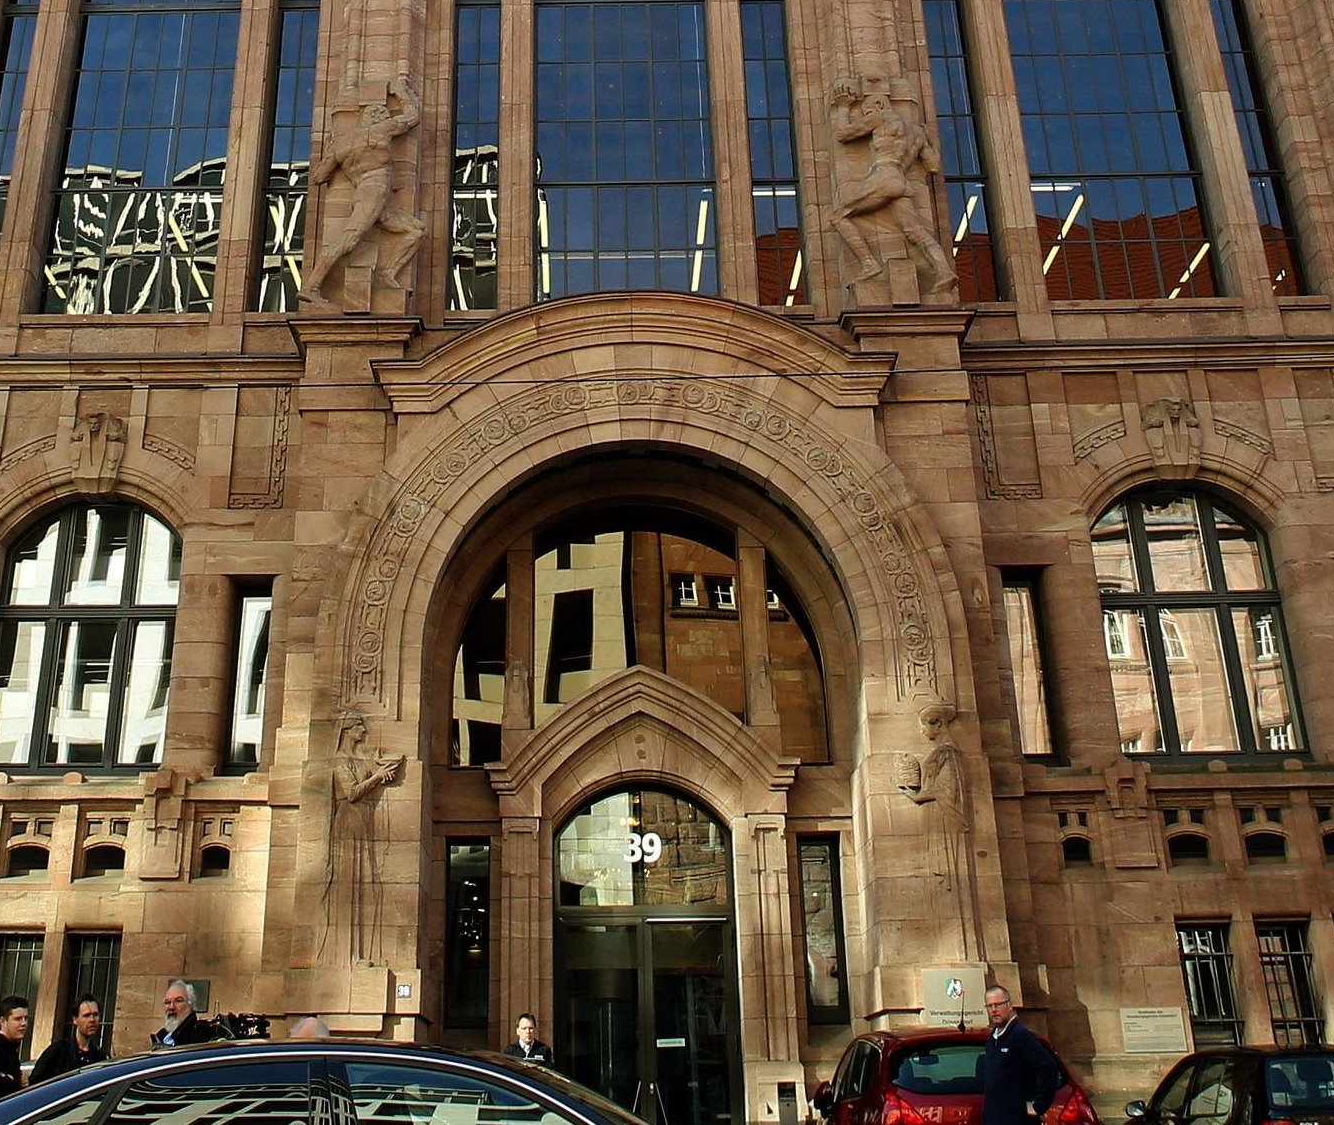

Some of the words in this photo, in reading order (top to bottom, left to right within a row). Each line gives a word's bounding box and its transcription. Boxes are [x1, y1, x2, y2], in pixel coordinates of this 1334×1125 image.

[624, 832, 662, 863] 39
[398, 985, 410, 997] 39
[929, 1009, 984, 1017] Verwaltunggericht
